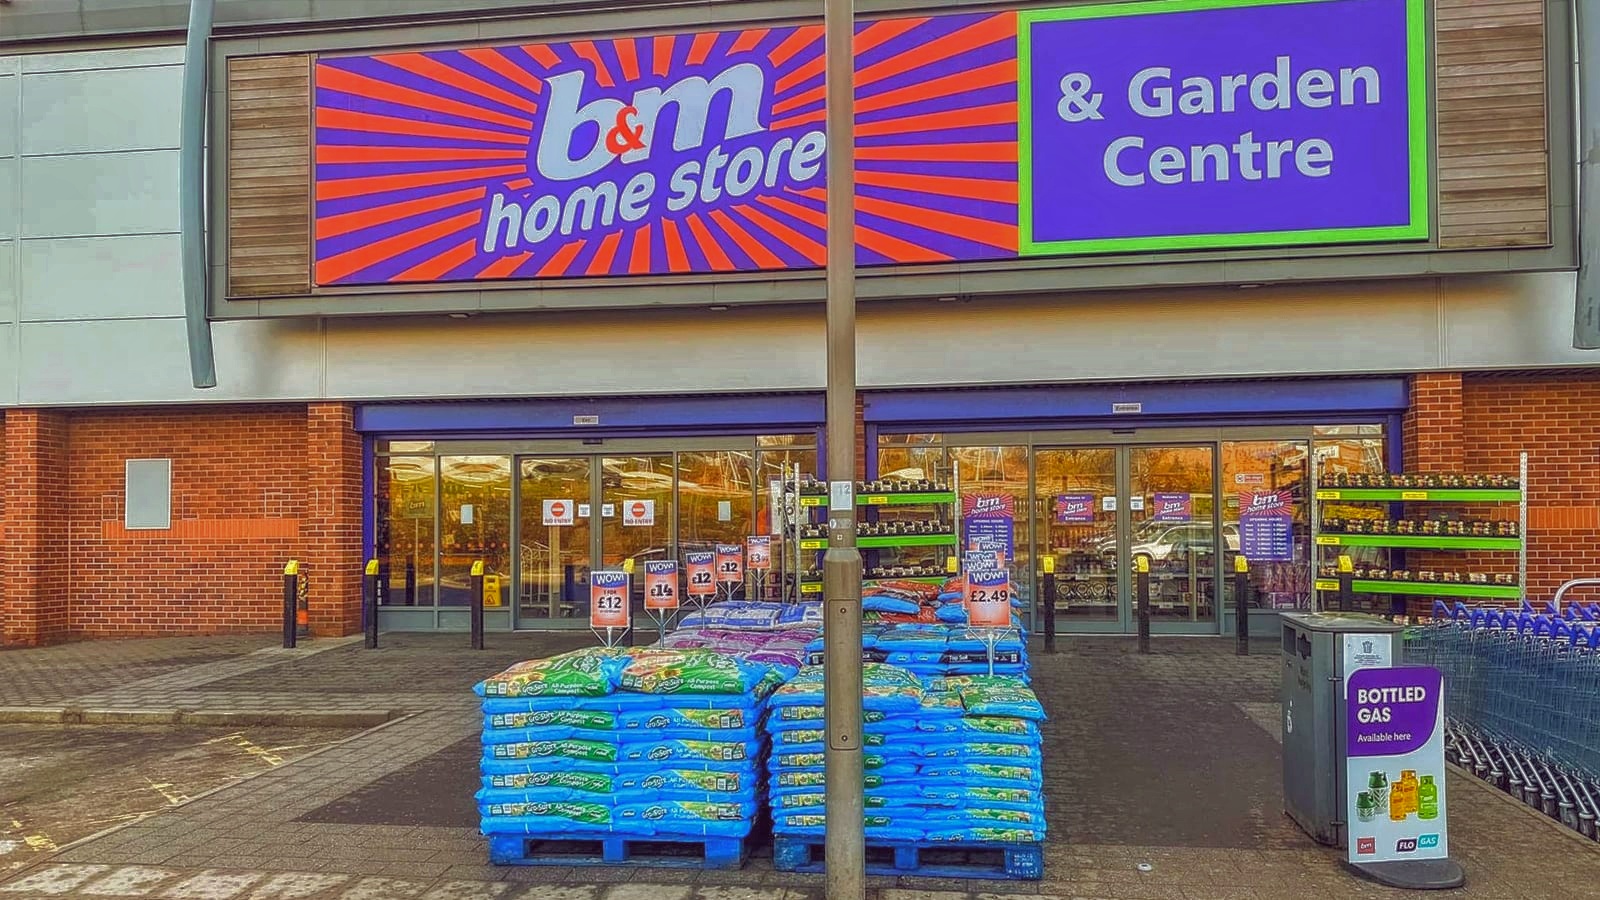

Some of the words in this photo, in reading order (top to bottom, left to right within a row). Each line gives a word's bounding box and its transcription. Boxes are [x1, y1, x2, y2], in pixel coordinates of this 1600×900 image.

[1056, 72, 1104, 123] &
[1128, 56, 1380, 117] Garden
[537, 63, 769, 181] b&m
[1103, 131, 1334, 187] Centre
[483, 172, 655, 253] home
[667, 131, 827, 211] store
[1246, 504, 1265, 513] home
[1267, 501, 1284, 509] store
[649, 563, 674, 572] WOW!
[596, 574, 625, 585] WOW!
[692, 572, 711, 584] £12
[972, 572, 1005, 583] WOW!
[650, 584, 673, 597] £14
[970, 590, 1008, 602] £2.49
[598, 596, 622, 608] £12
[1358, 686, 1426, 704] BOTTLED
[1357, 707, 1391, 723] GAS
[1357, 732, 1393, 743] Available
[1393, 732, 1411, 741] here
